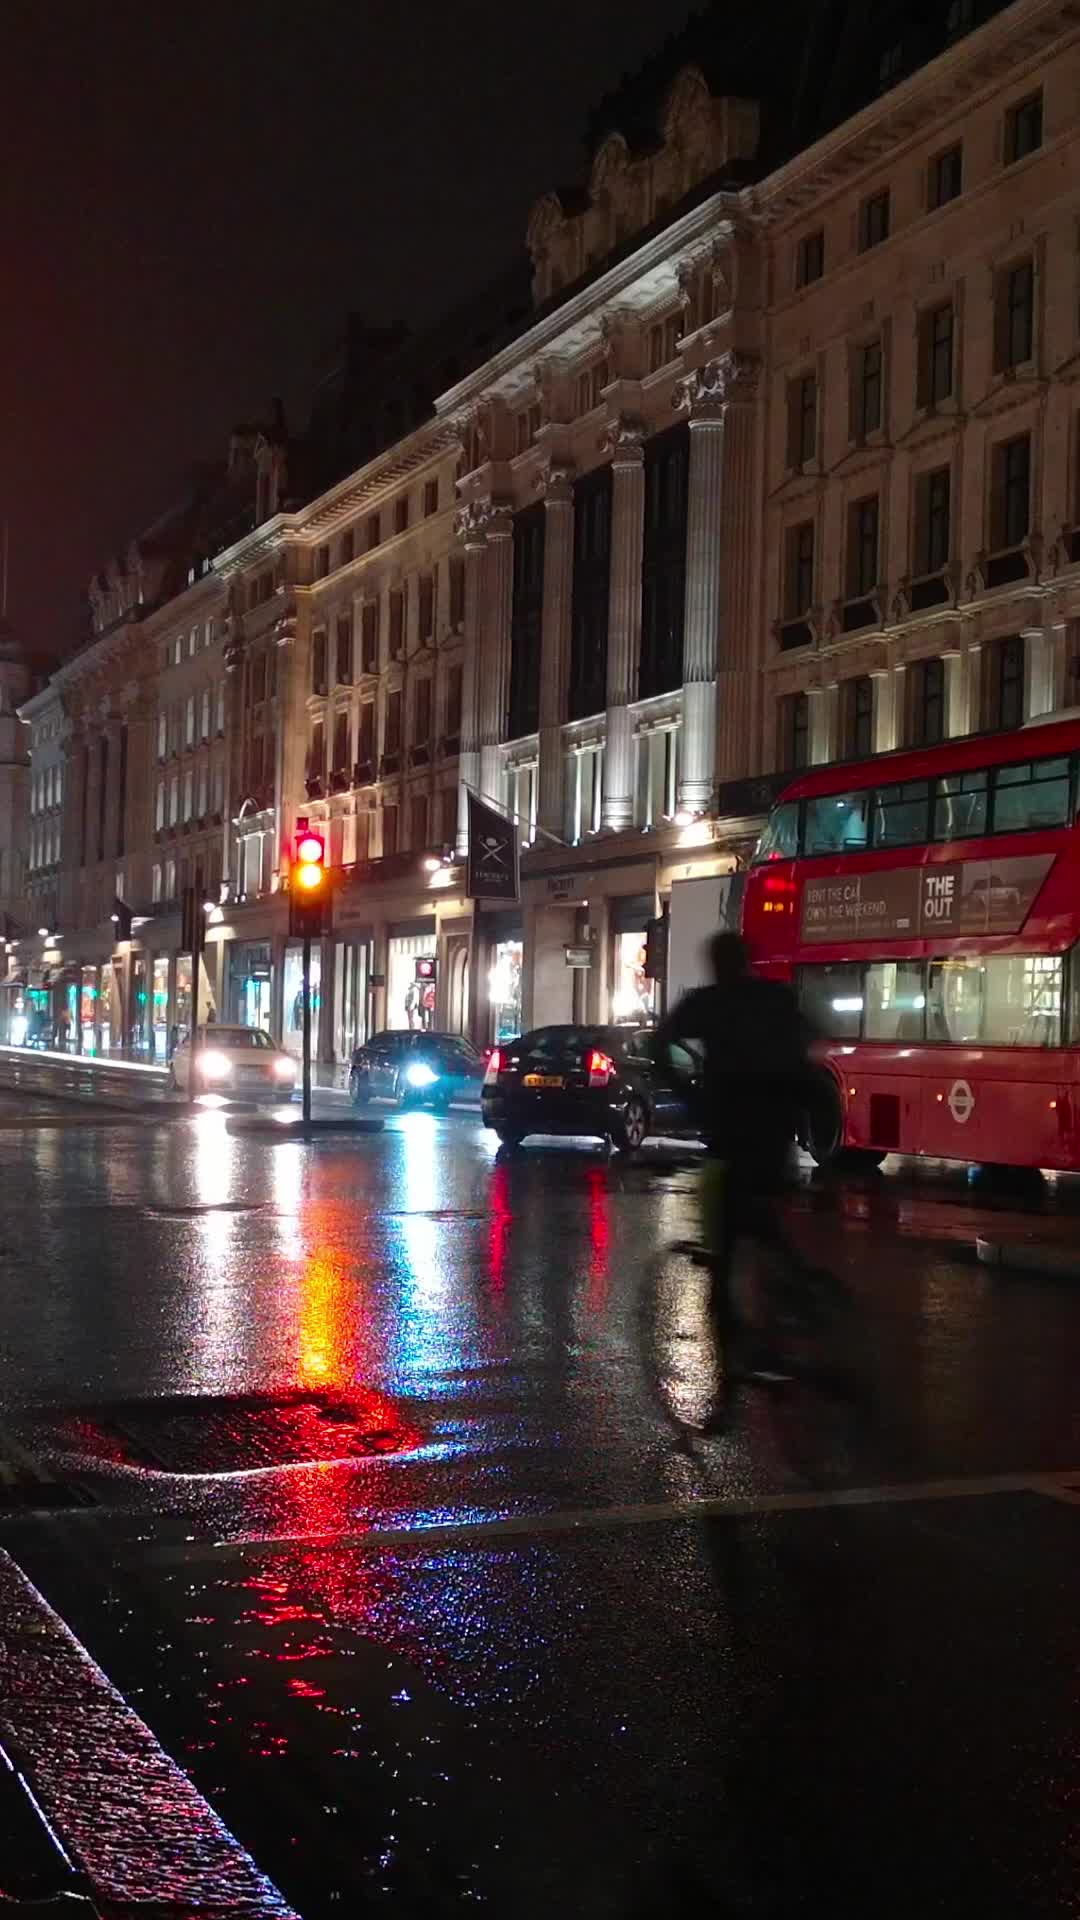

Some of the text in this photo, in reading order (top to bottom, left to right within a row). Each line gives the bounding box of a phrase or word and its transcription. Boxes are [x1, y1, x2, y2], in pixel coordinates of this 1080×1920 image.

[828, 886, 843, 900] THE
[926, 875, 954, 896] THE
[829, 903, 844, 918] THE
[925, 897, 953, 918] OUT
